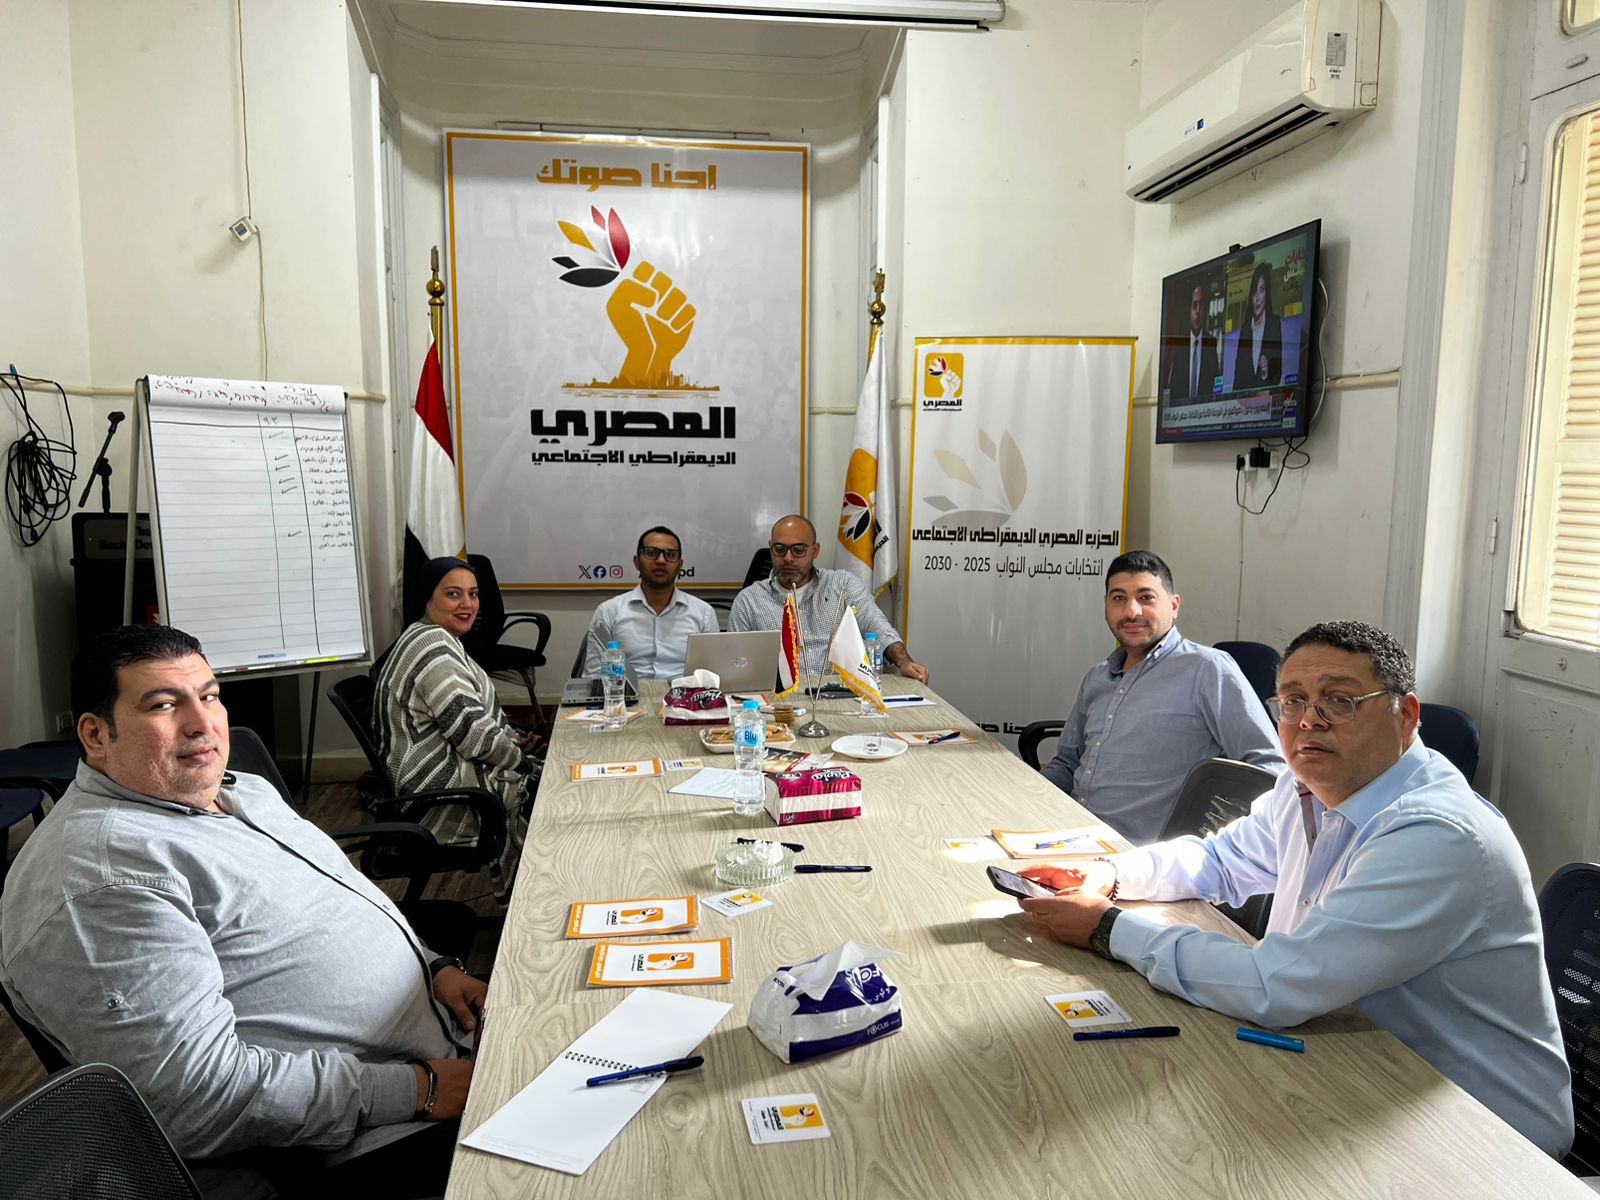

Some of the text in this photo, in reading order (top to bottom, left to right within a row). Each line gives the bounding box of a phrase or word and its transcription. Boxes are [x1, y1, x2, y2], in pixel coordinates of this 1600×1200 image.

[536, 158, 642, 192] صوتك
[530, 406, 736, 446] المصري
[531, 449, 736, 467] الديمقراطي الاجتماعي
[1085, 529, 1119, 550] الحزب
[924, 555, 951, 571] 2030
[963, 557, 991, 572] 2025
[995, 556, 1026, 578] النواب
[1028, 557, 1062, 579] مجلس
[1065, 558, 1104, 580] انتخابات
[867, 1022, 890, 1036] FOCUS
